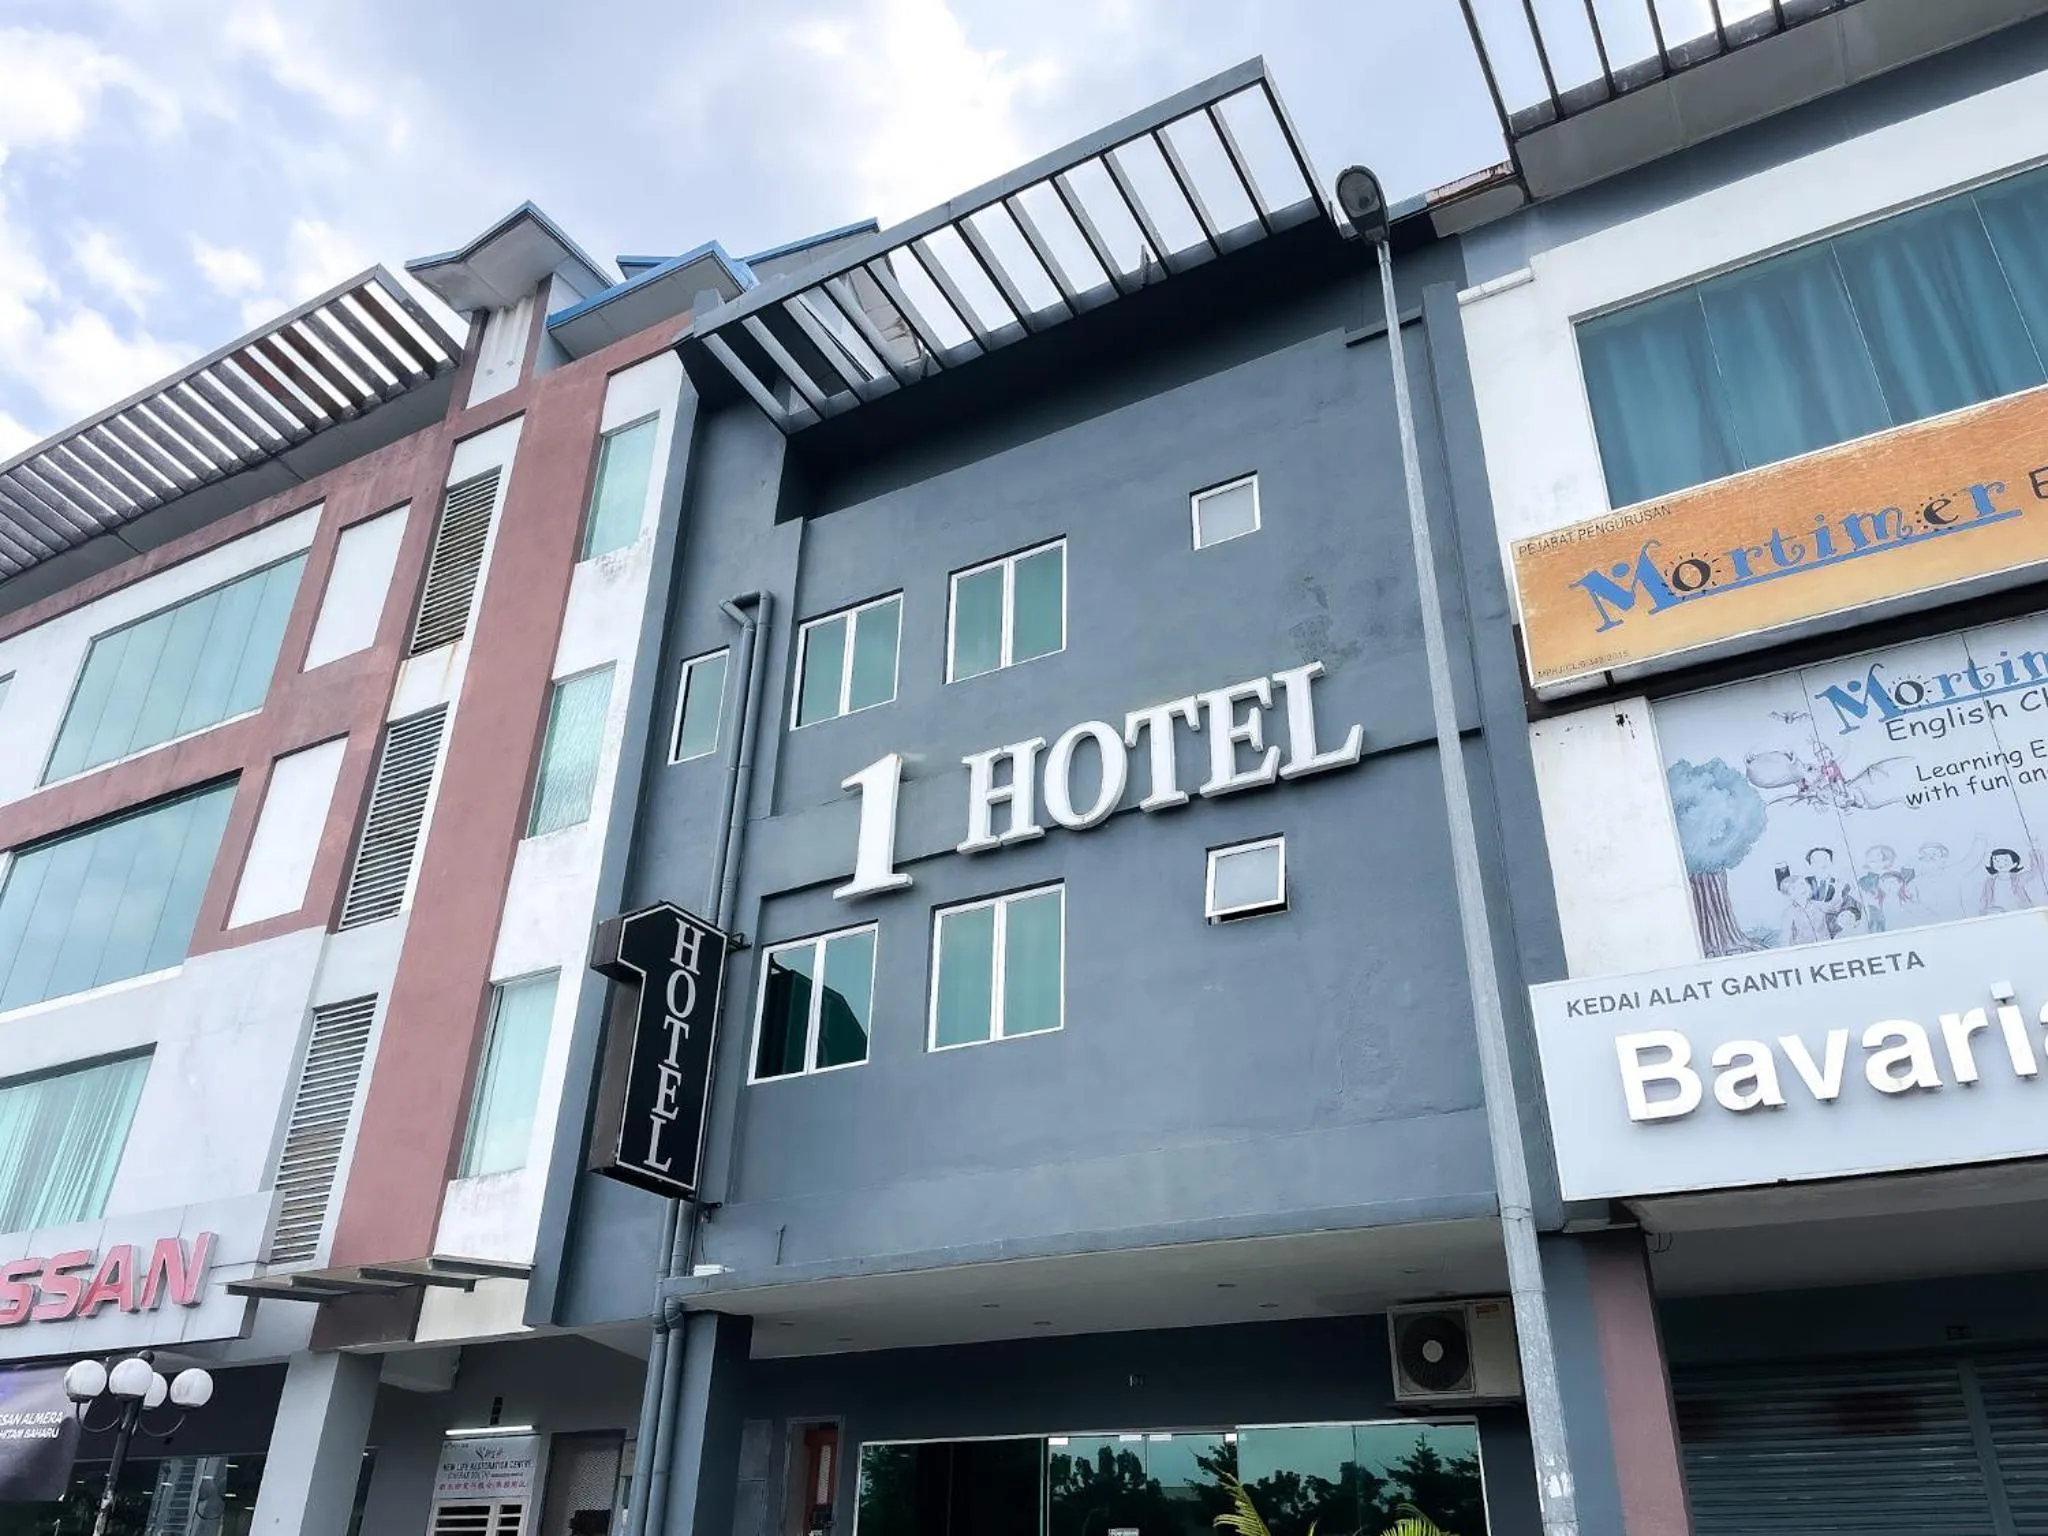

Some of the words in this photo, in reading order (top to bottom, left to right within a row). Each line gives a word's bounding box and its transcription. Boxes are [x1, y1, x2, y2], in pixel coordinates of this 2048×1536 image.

[1518, 532, 1575, 557] PEJABAT
[1577, 504, 1672, 540] PENGURUSAN
[1568, 480, 2022, 632] Mortimer
[1885, 698, 2008, 742] English
[833, 752, 914, 900] 1
[956, 660, 1364, 853] HOTEL
[1906, 779, 1960, 807] with
[1966, 774, 2010, 797] fun
[1915, 750, 2024, 782] Learning
[1566, 991, 1641, 1018] KEDAI
[1647, 980, 1714, 1008] ALAT
[1720, 966, 1803, 997] GANTI
[1809, 949, 1926, 984] KERETA
[644, 917, 706, 1173] HOTEL
[1614, 980, 2048, 1123] Bavari
[20, 1411, 64, 1425] ALMERA
